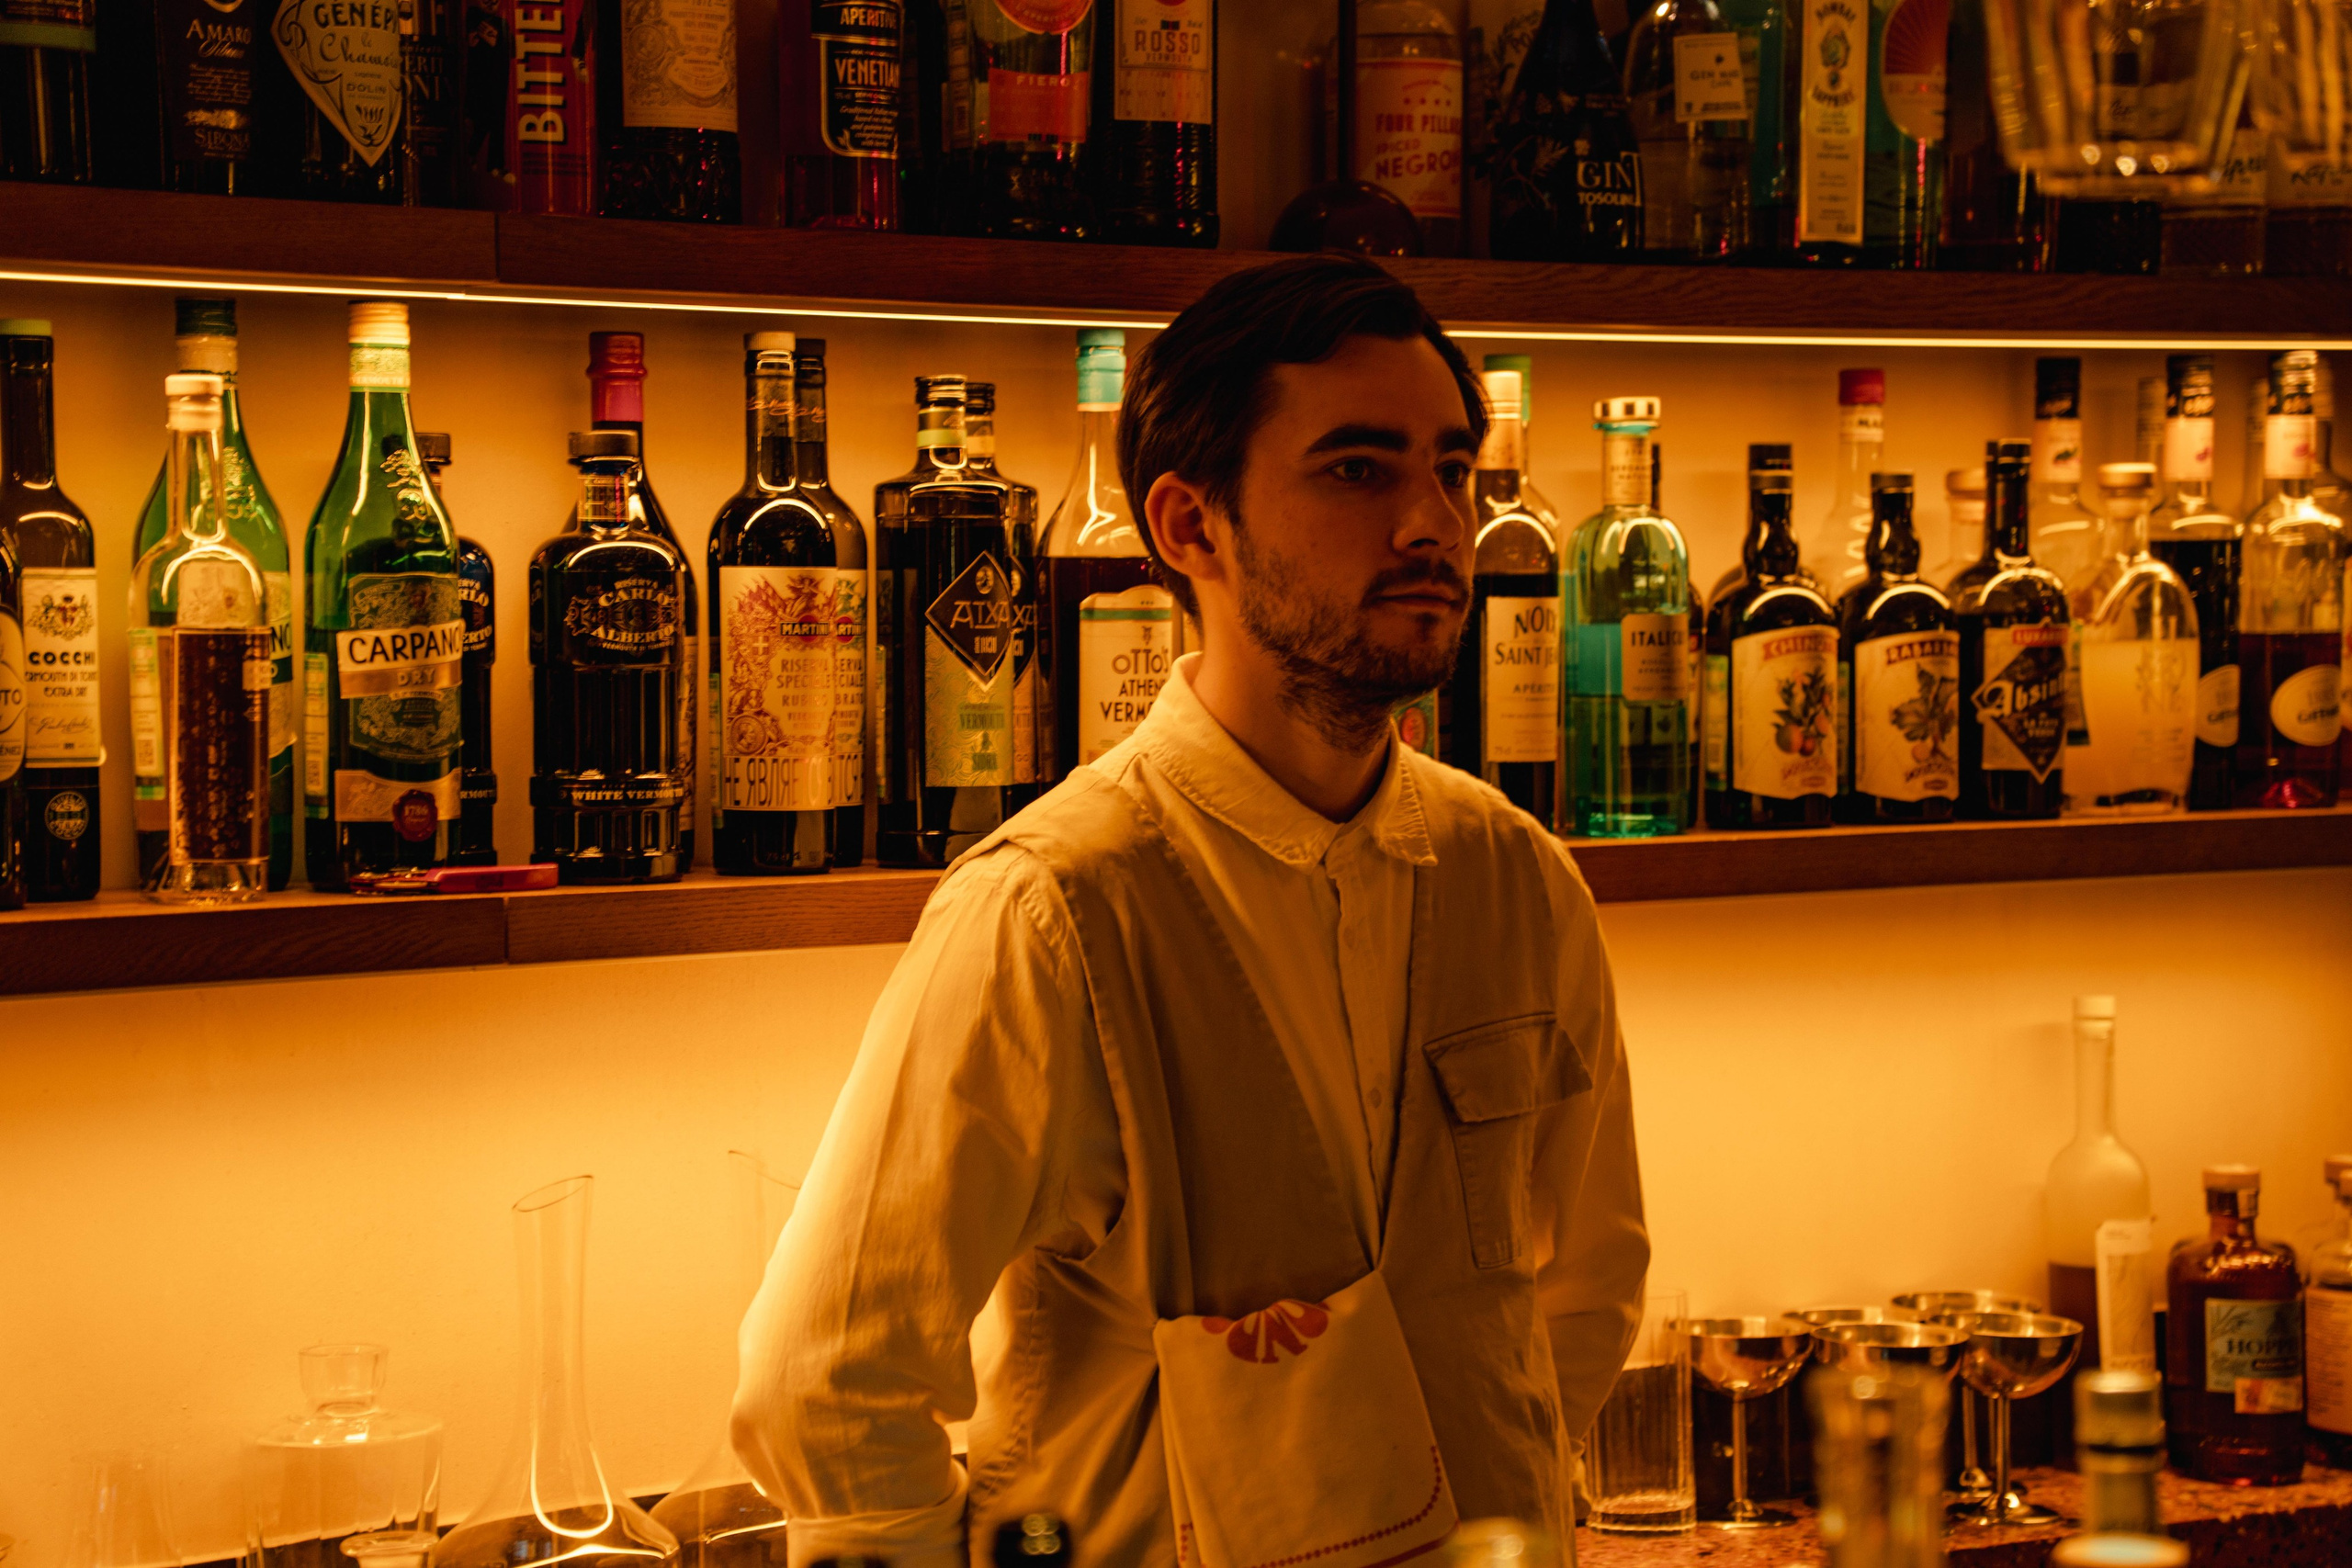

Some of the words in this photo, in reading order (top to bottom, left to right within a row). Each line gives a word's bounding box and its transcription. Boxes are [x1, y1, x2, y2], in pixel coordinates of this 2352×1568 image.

[186, 18, 253, 44] AMARO
[1134, 30, 1201, 55] ROSSO
[515, 0, 565, 142] BITTE
[1016, 75, 1071, 87] FIERO
[1577, 160, 1633, 190] GIN
[598, 588, 671, 607] CARLO
[950, 601, 1012, 630] ATXA
[590, 625, 675, 644] ALBERTO
[781, 623, 829, 637] MARTINI
[1495, 641, 1541, 666] SAINT
[1544, 647, 1557, 669] JE
[397, 667, 436, 687] DRY
[1118, 680, 1165, 697] ATHEN
[571, 790, 624, 801] WHITE
